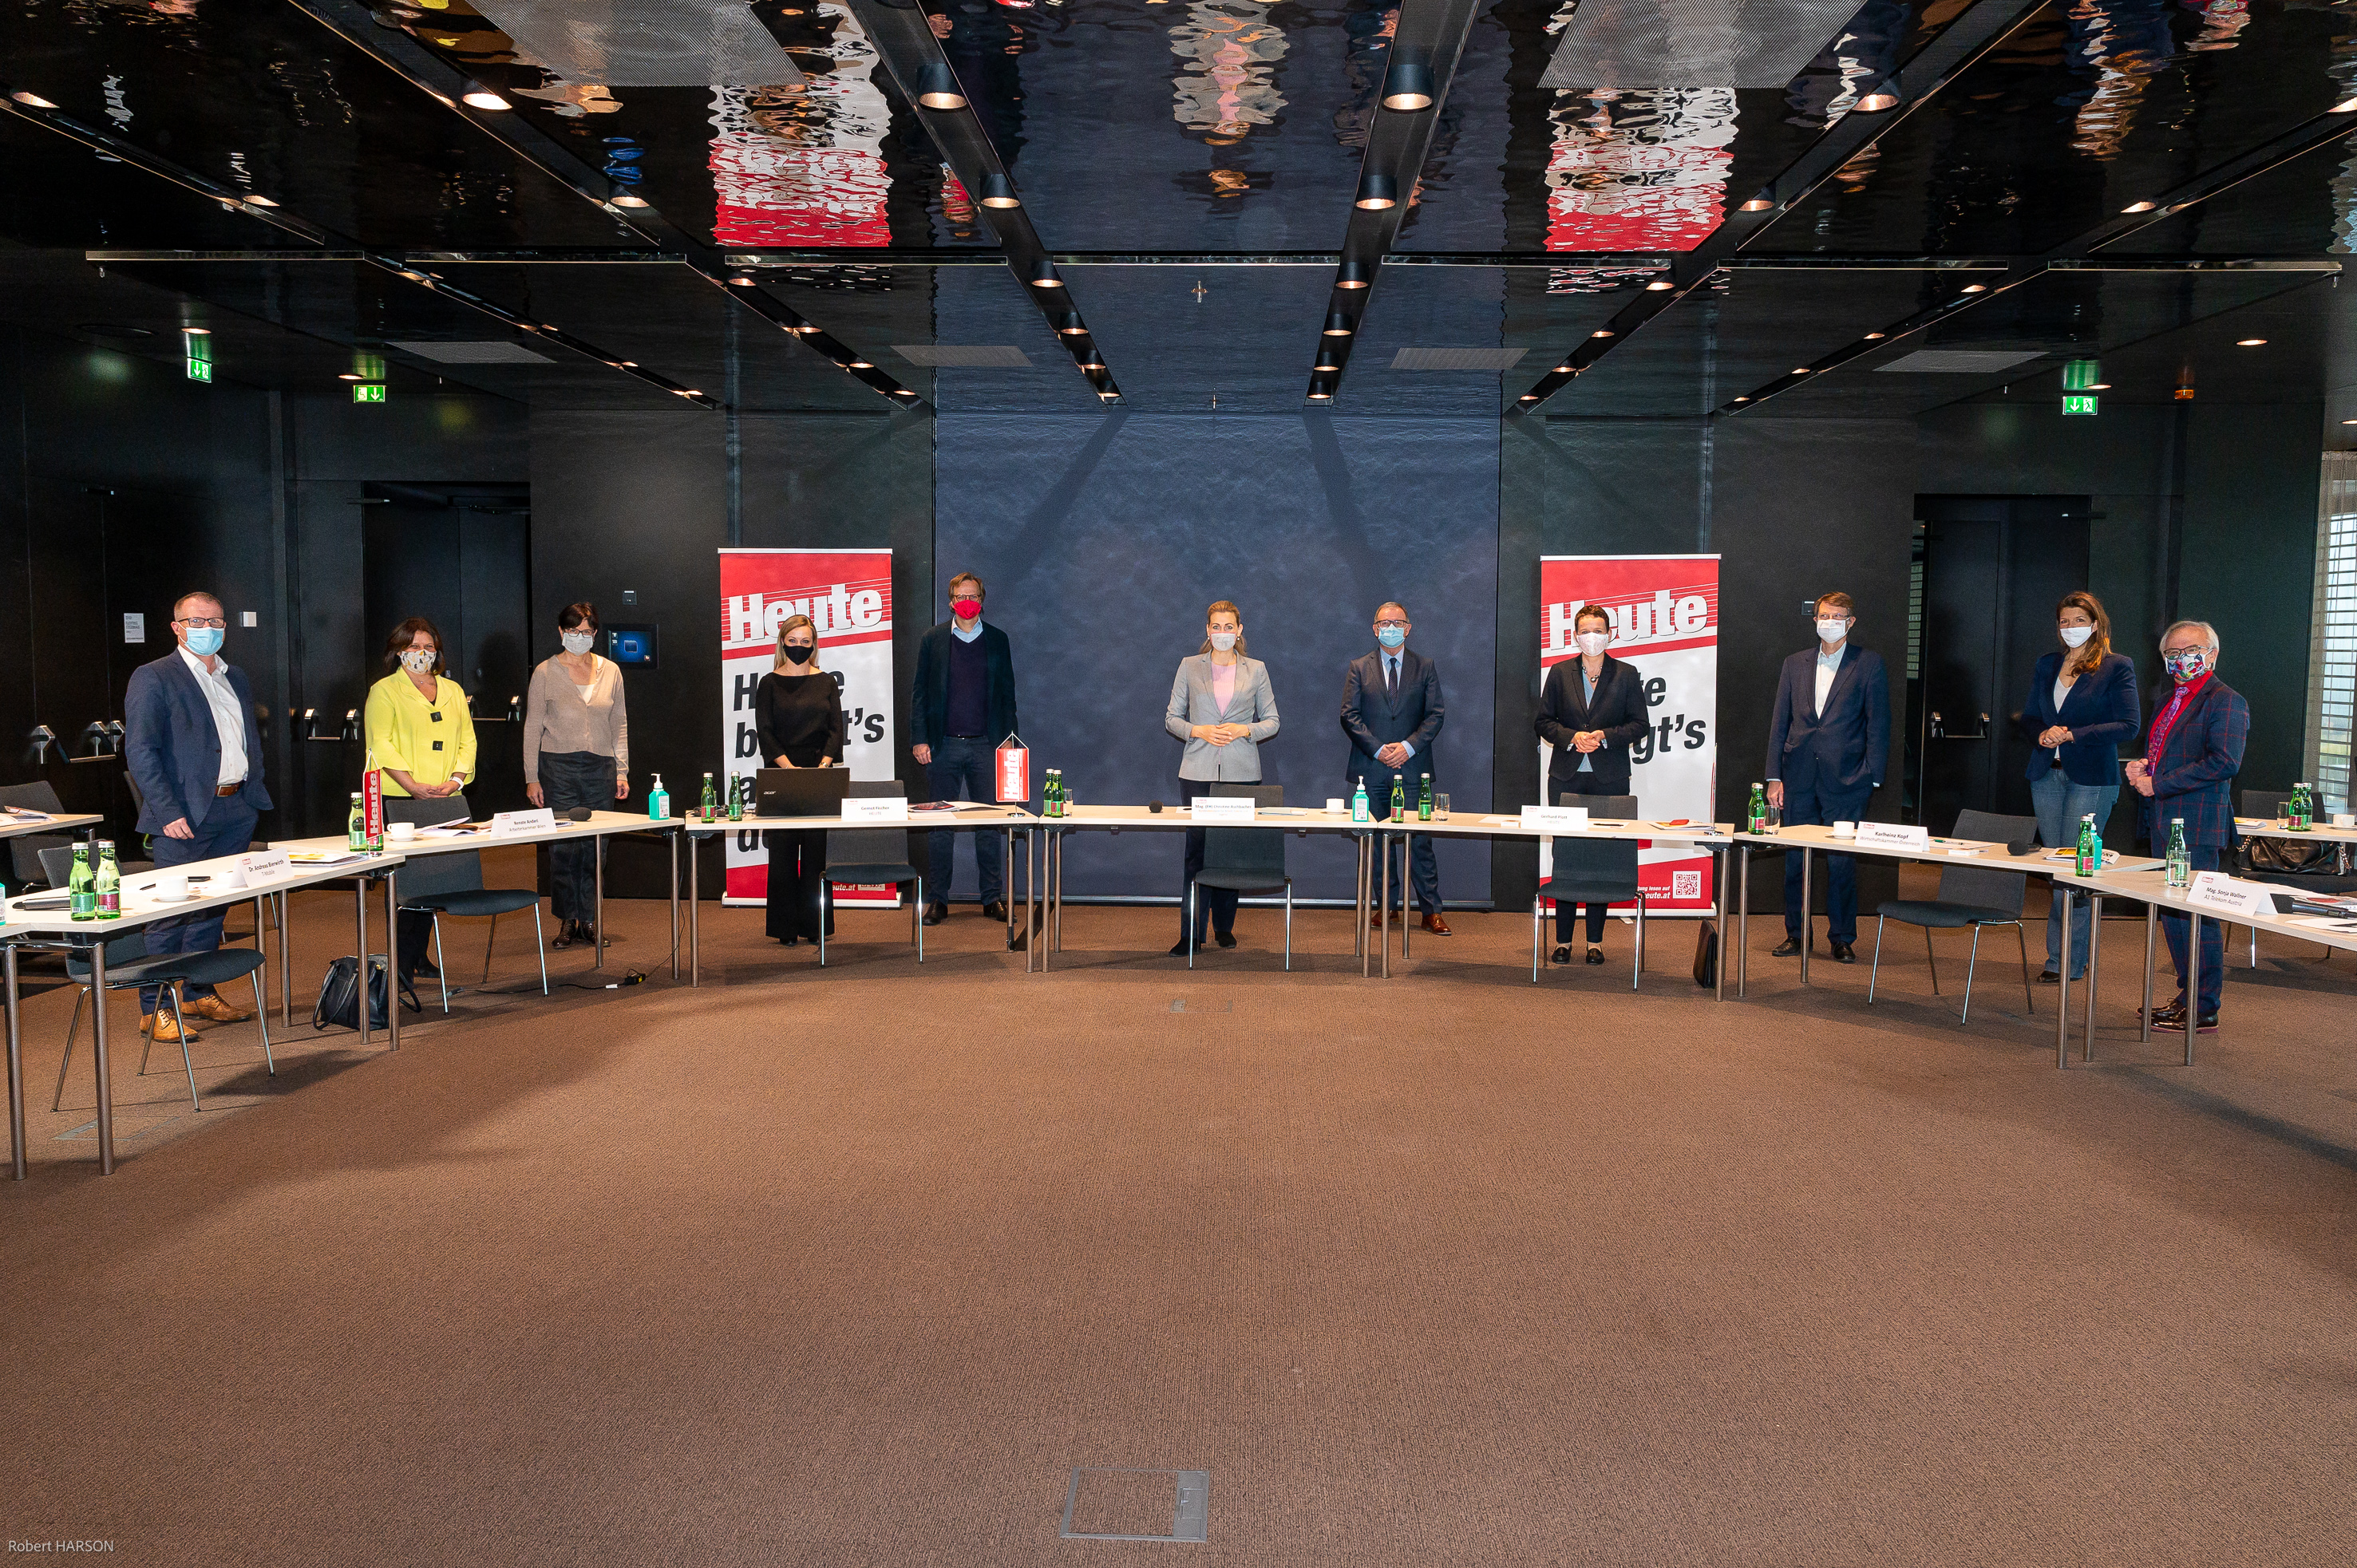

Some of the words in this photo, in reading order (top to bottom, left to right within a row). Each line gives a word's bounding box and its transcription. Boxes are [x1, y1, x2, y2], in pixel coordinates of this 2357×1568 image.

[730, 584, 883, 643] Heute
[370, 772, 378, 835] Heute
[2210, 895, 2228, 903] Telekom
